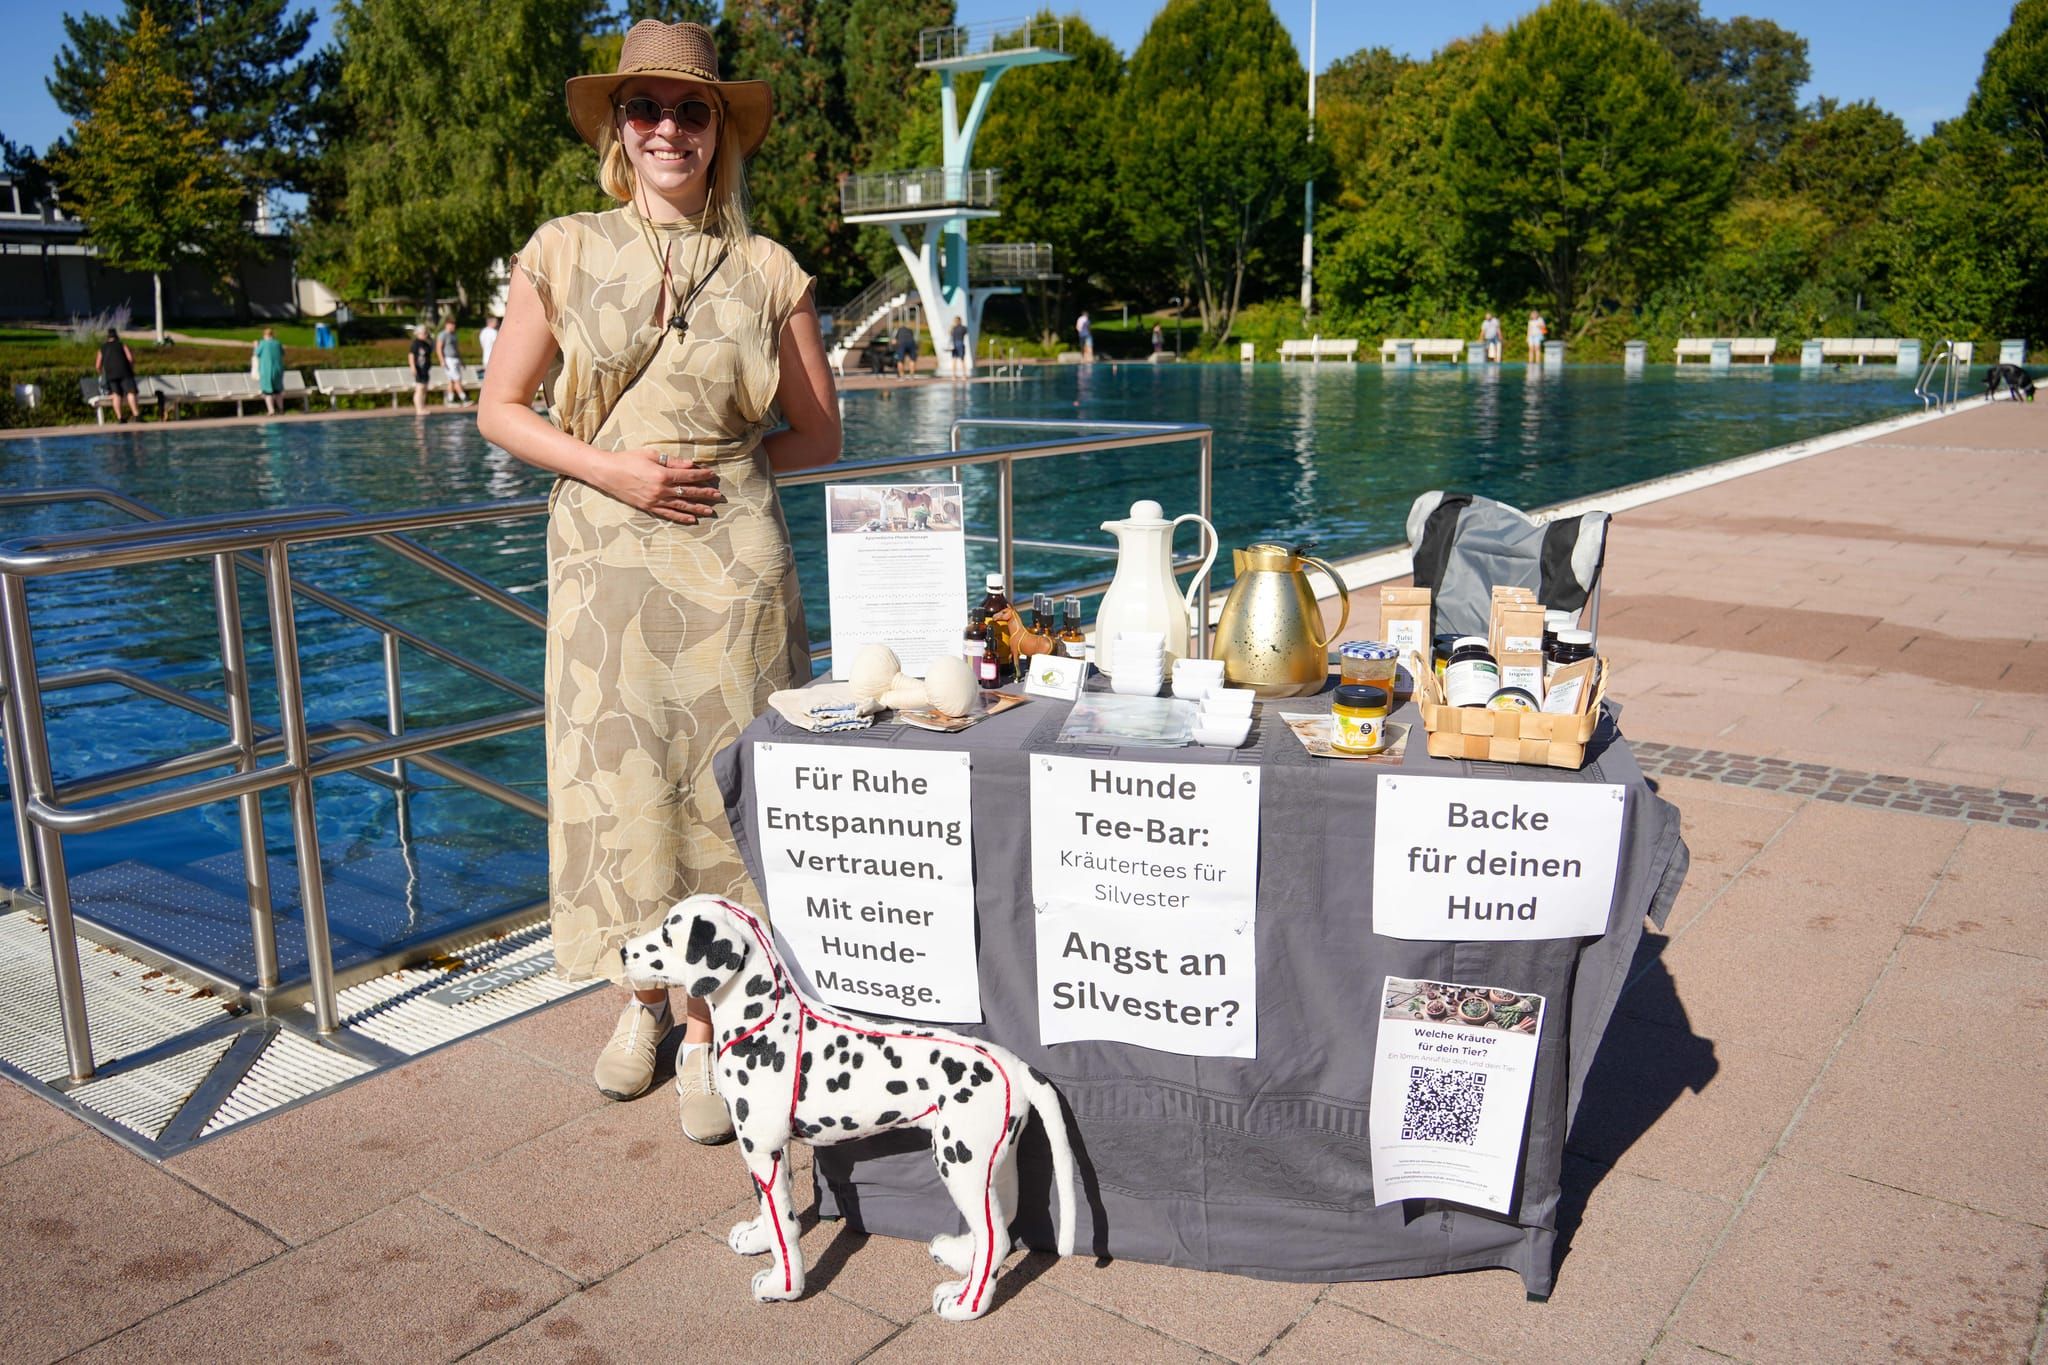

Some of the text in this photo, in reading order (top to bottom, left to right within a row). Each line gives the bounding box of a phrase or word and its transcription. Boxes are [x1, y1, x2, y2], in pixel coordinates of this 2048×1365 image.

[795, 766, 928, 795] Für Ruhe
[1090, 769, 1197, 800] Hunde
[766, 806, 963, 846] Entspannung
[1075, 811, 1210, 847] Tee-Bar:
[1447, 802, 1550, 831] Backe
[786, 848, 944, 881] Vertrauen.
[1060, 850, 1227, 882] Kräutertees für
[1407, 846, 1582, 878] für deinen
[806, 896, 934, 927] Mit einer
[1094, 884, 1190, 908] Silvester
[1447, 895, 1538, 921] Hund
[821, 935, 926, 964] Hunde-
[1062, 931, 1226, 976] Angst an
[815, 970, 942, 1007] Massage.
[1052, 981, 1240, 1028] Silvester?
[1414, 1027, 1497, 1045] Welche Kräuter
[1418, 1041, 1488, 1057] für dein Tier?
